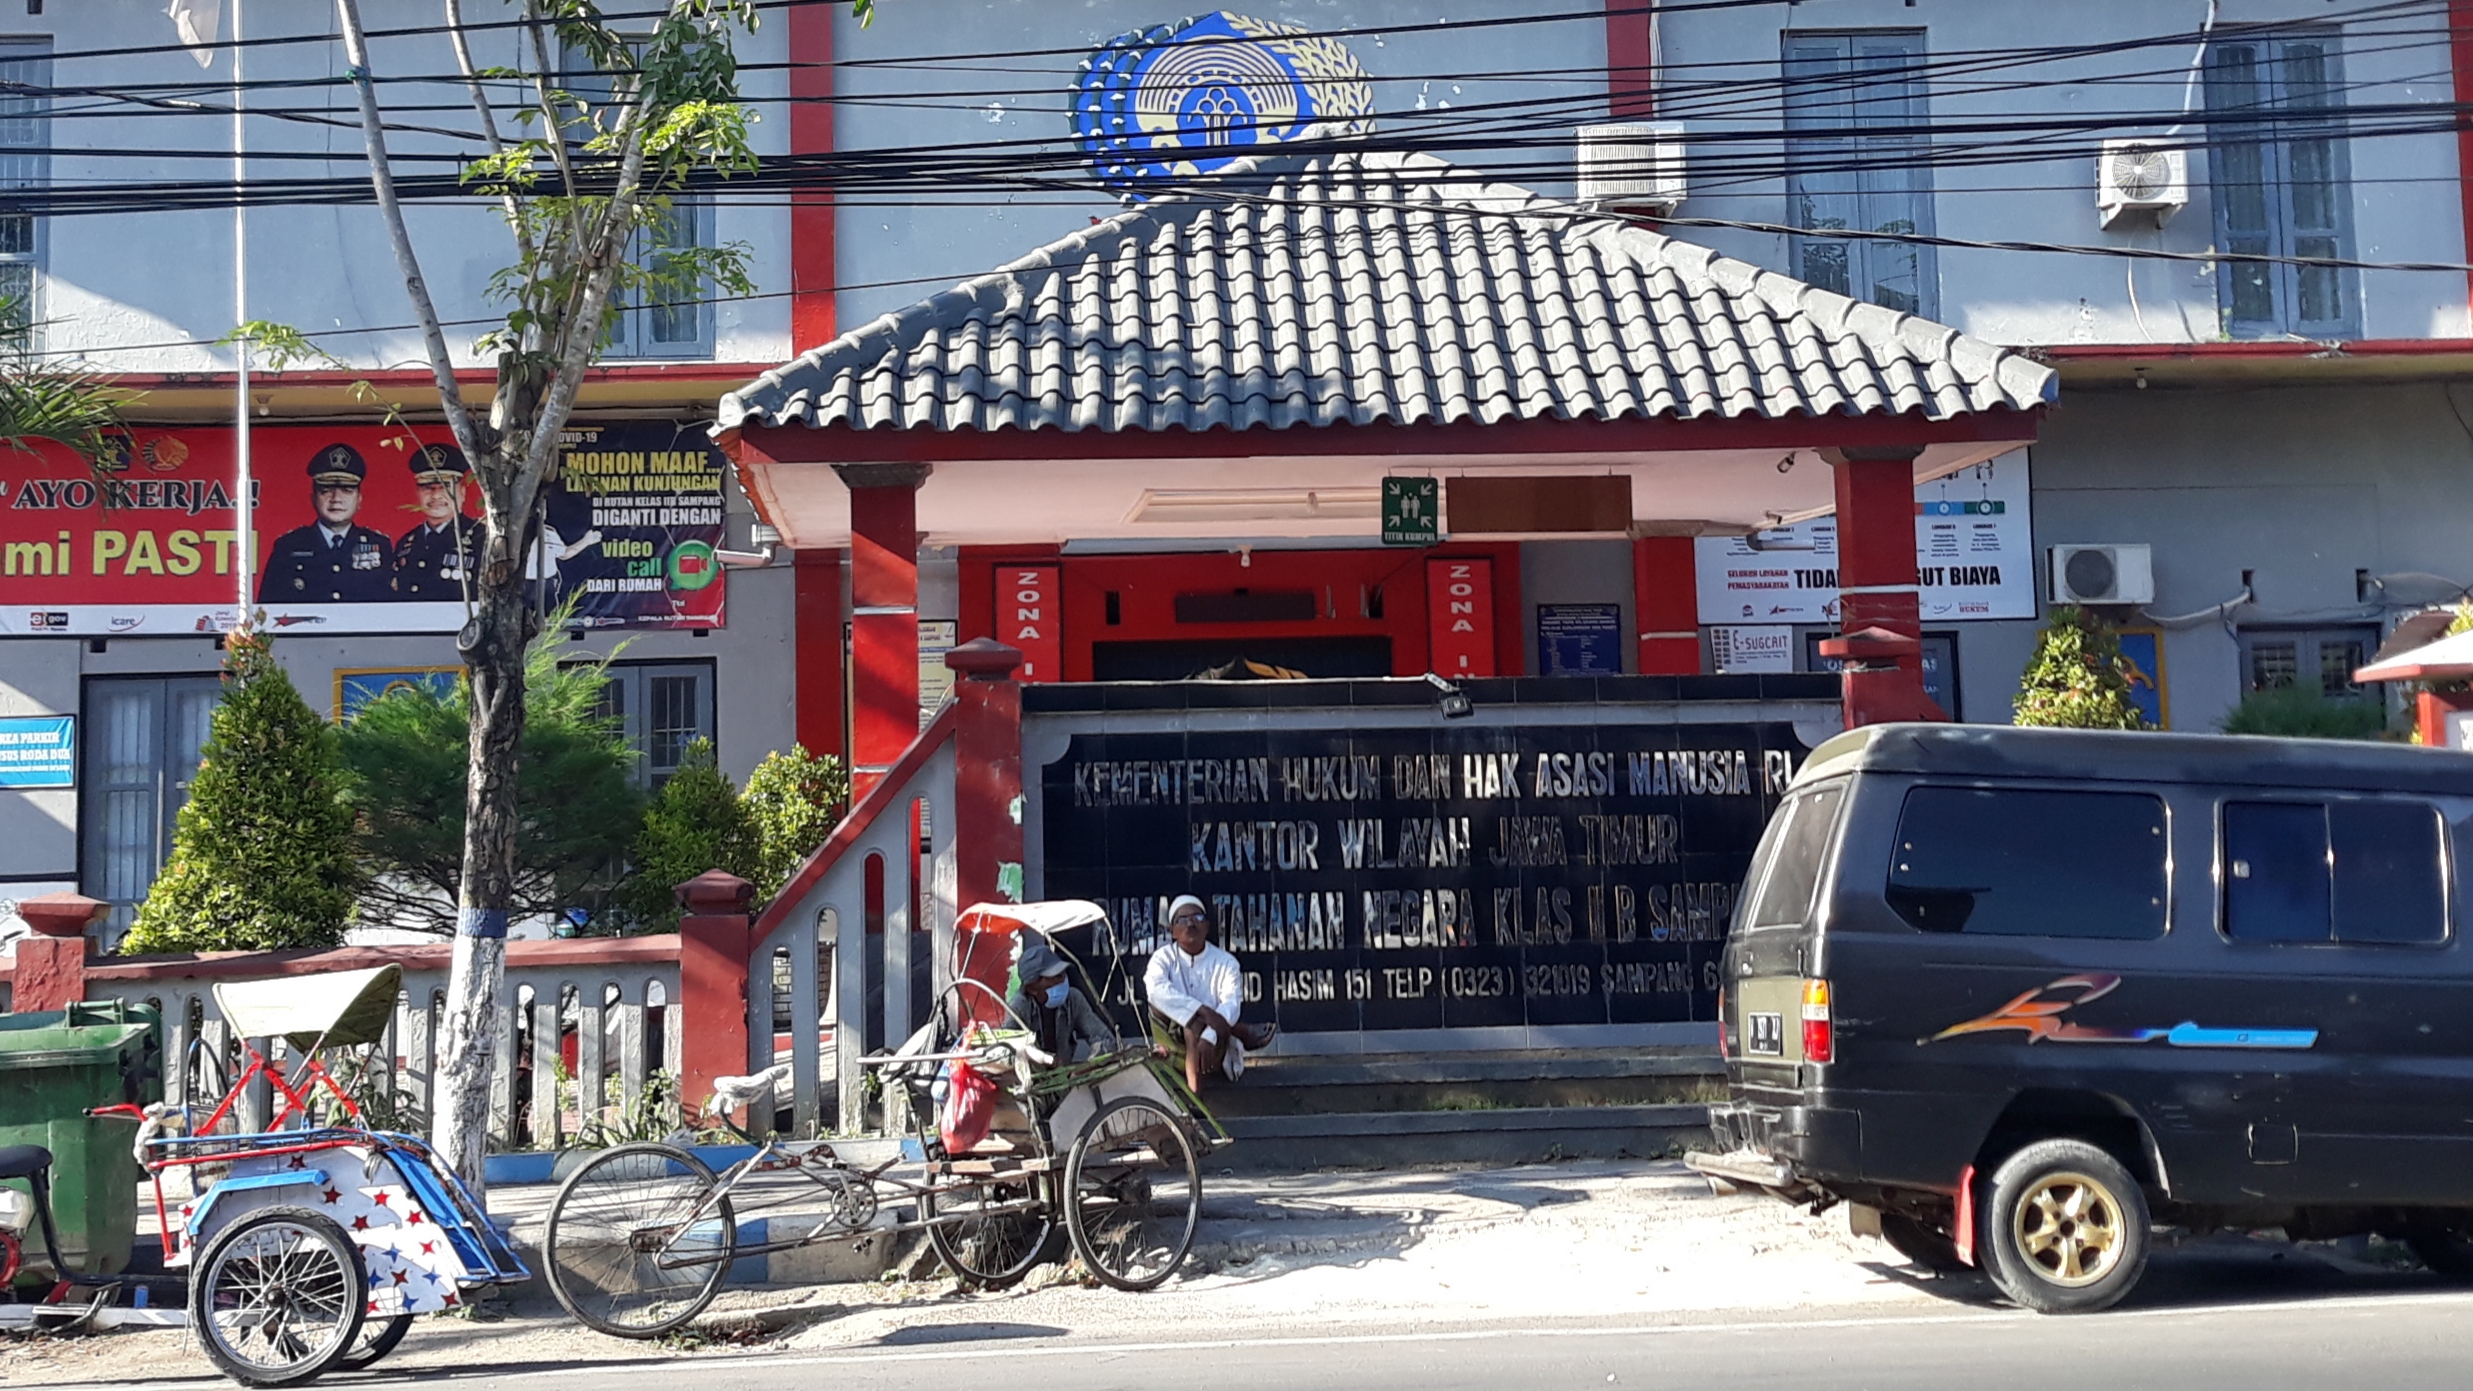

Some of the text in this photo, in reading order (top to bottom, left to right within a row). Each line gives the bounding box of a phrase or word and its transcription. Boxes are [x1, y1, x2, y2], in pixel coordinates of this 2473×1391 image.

[566, 451, 721, 475] MOHON MAAF...
[10, 478, 96, 510] AYO
[634, 475, 721, 492] KUNJUNGAN
[604, 496, 633, 507] RUTAN
[635, 496, 661, 506] KELAS
[678, 496, 721, 506] SAMPANG
[592, 508, 721, 526] DIGANTI DENGAN
[602, 539, 653, 558] video
[627, 558, 662, 577] call
[1794, 569, 1840, 590] TIDA
[1949, 565, 2002, 586] BIAYA
[587, 578, 662, 593] DARI RUMAH
[1017, 571, 1041, 640] ZONA
[1449, 565, 1475, 633] ZONA
[111, 615, 136, 626] icare
[1074, 757, 1270, 807] KEMENTERIAN
[1282, 754, 1382, 802] HUKUM
[1393, 754, 1452, 801] DAN
[1462, 752, 1522, 800] HAK
[1535, 751, 1616, 799] ASASI
[1627, 749, 1752, 797] MANUSIA
[1191, 813, 1680, 874] KANTOR WILAYAH JAWA TIMUR
[1212, 891, 1346, 953] TAHANAN
[1362, 887, 1478, 950] NEGARA
[1493, 885, 1573, 946] KLAS
[1274, 968, 1335, 1001] HASIM
[1344, 966, 1373, 1000] 151
[1441, 965, 1516, 998] (0323)
[1525, 964, 1591, 996] 321019
[1600, 963, 1694, 995] SAMPANG
